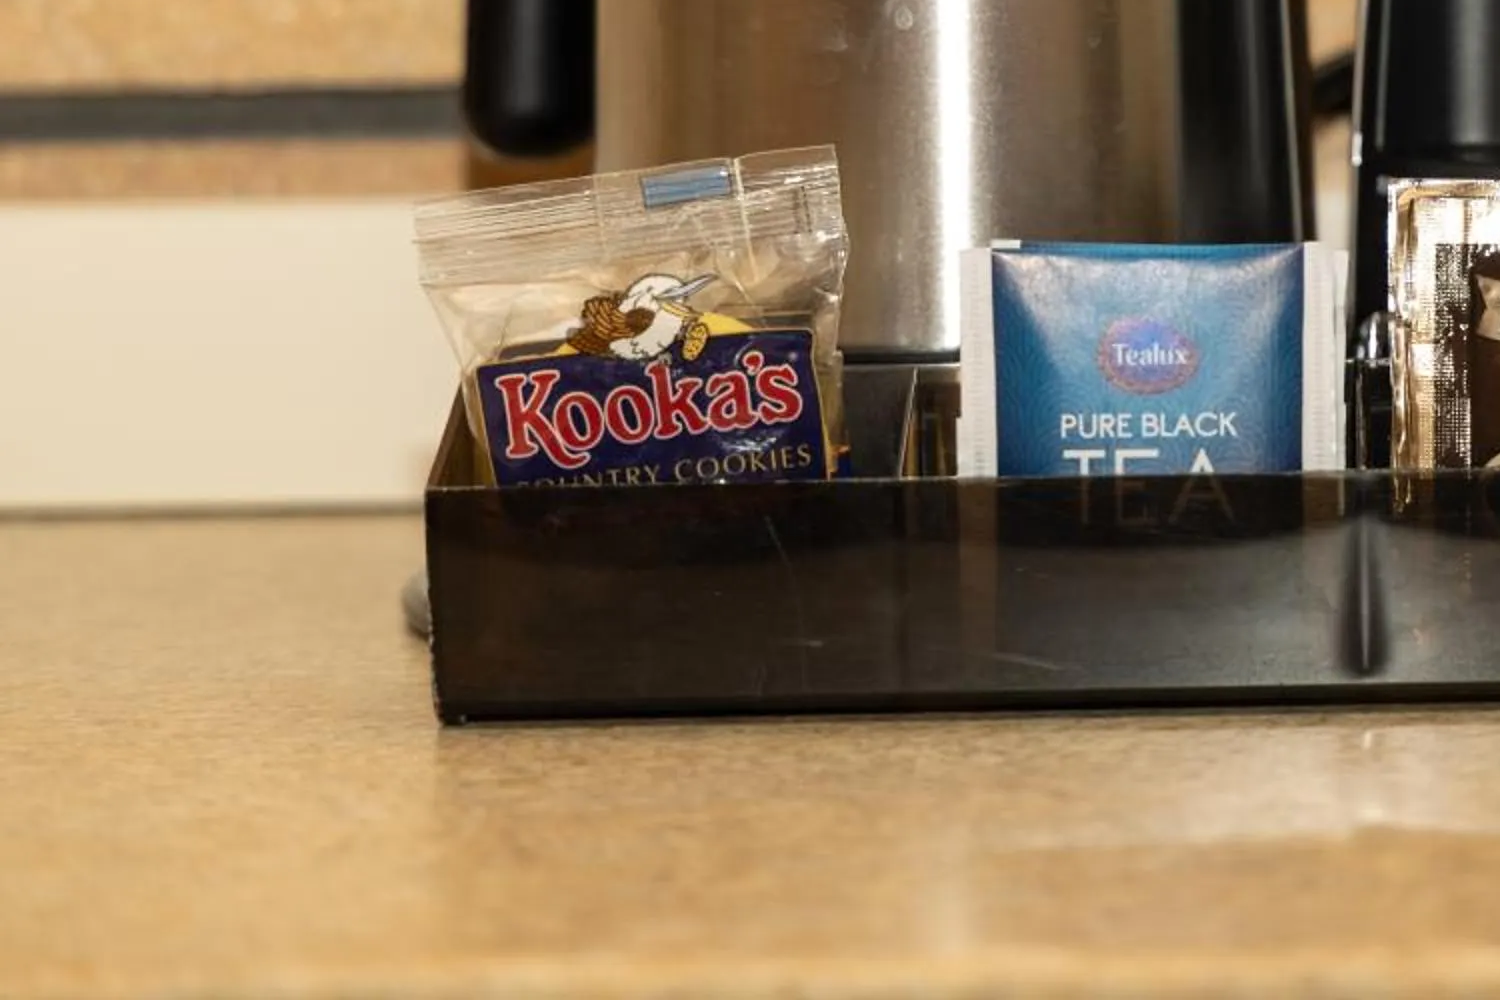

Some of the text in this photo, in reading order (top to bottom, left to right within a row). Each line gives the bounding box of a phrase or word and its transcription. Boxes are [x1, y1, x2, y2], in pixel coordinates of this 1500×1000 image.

[1111, 341, 1190, 367] Tealux
[495, 350, 804, 468] Kooka's
[1059, 411, 1239, 438] PURE BLACK
[674, 445, 812, 484] COOKIES
[1062, 448, 1236, 525] TEA
